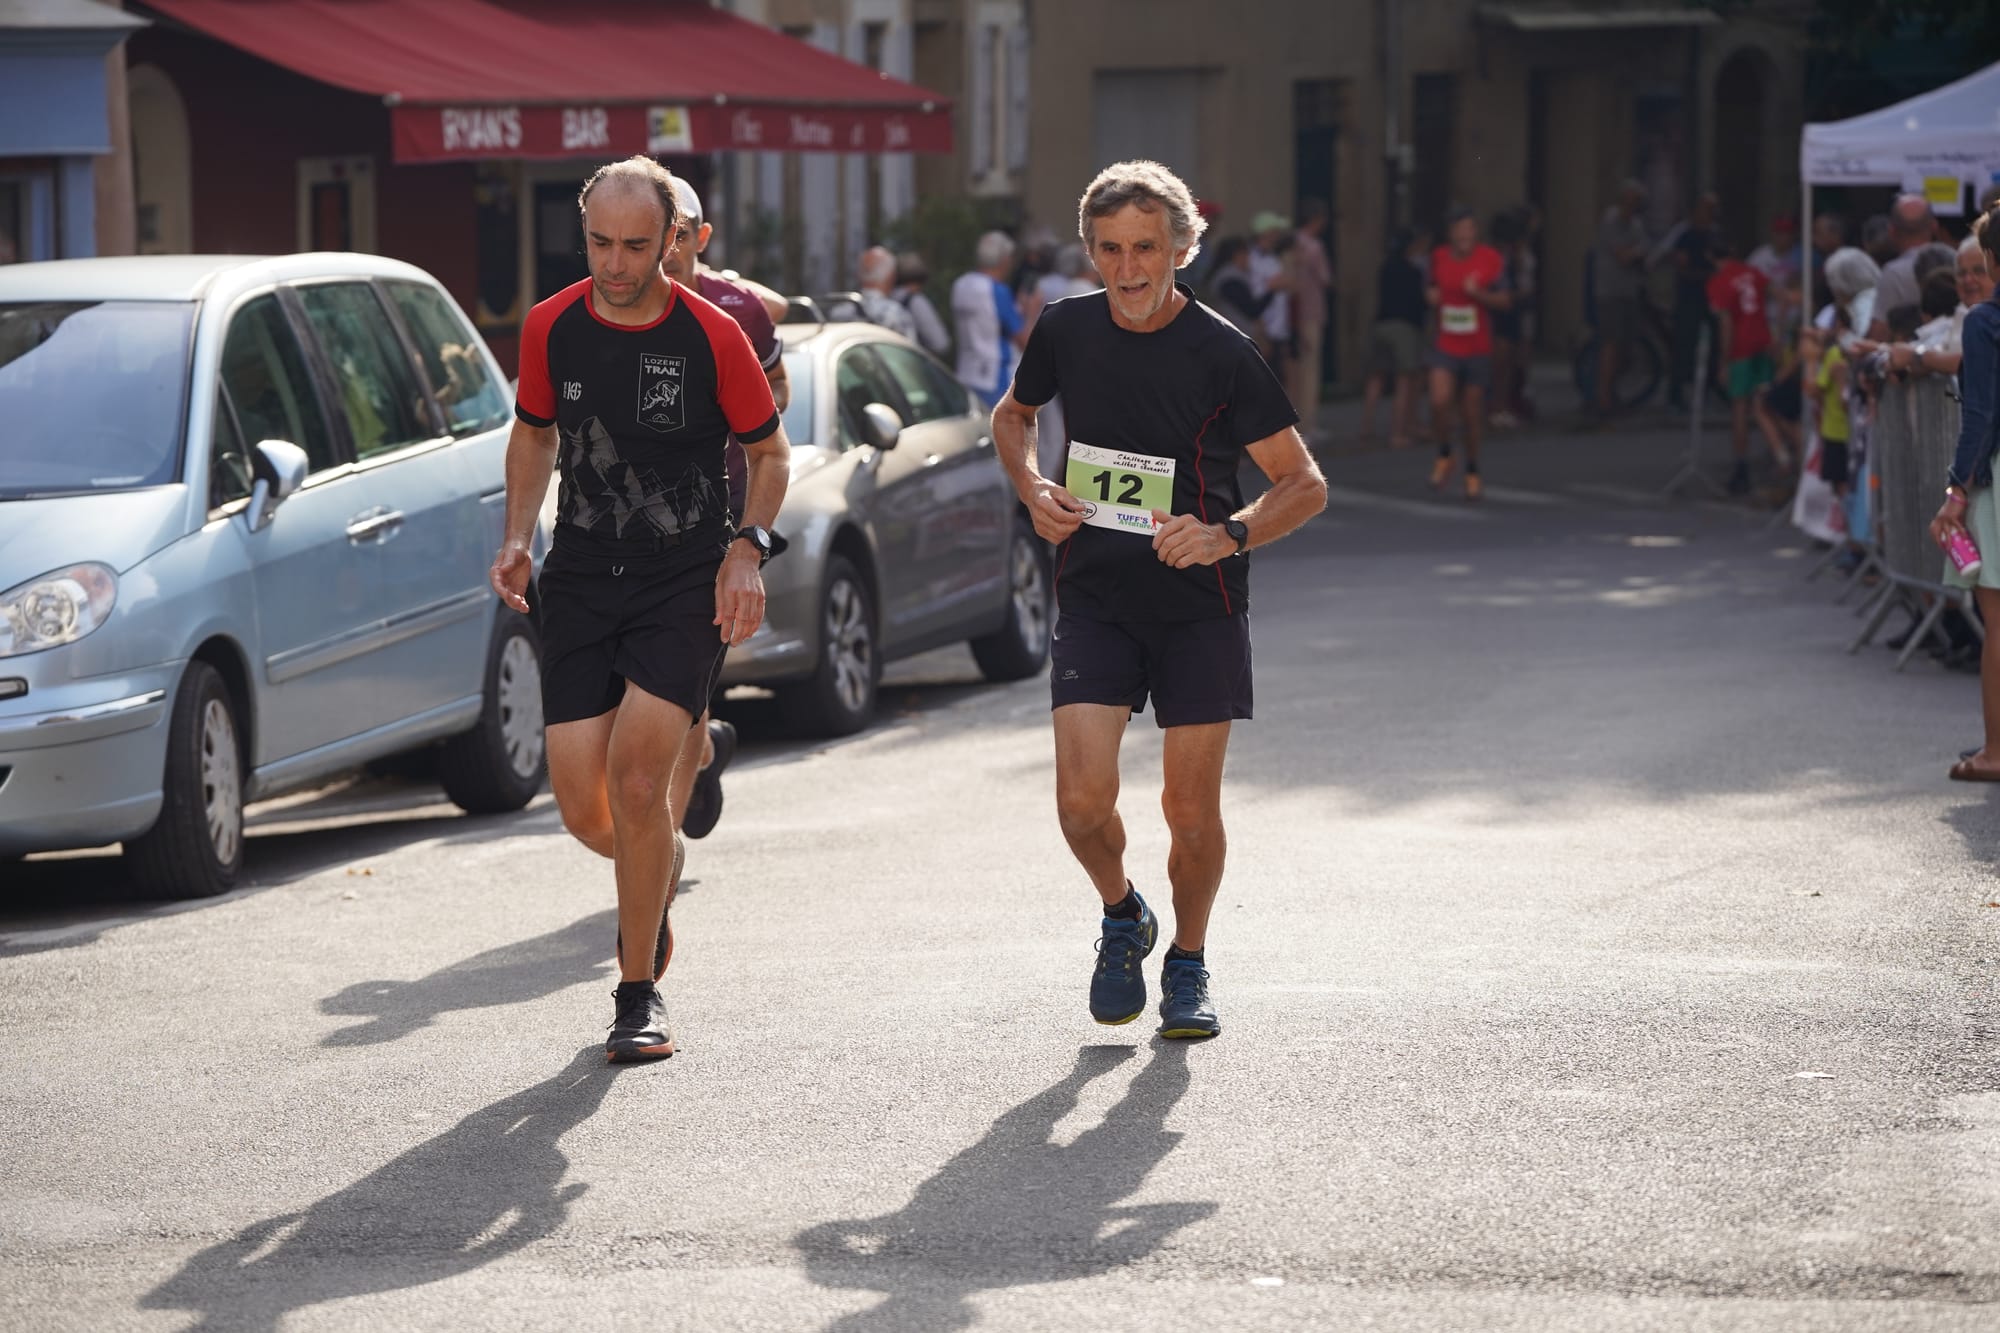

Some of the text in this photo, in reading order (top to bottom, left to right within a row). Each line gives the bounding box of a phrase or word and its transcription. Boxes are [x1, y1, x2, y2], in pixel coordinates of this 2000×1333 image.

[562, 107, 610, 149] BAR
[645, 365, 680, 376] TRAIL
[1094, 471, 1143, 506] 12
[1117, 513, 1149, 524] TUFF'S
